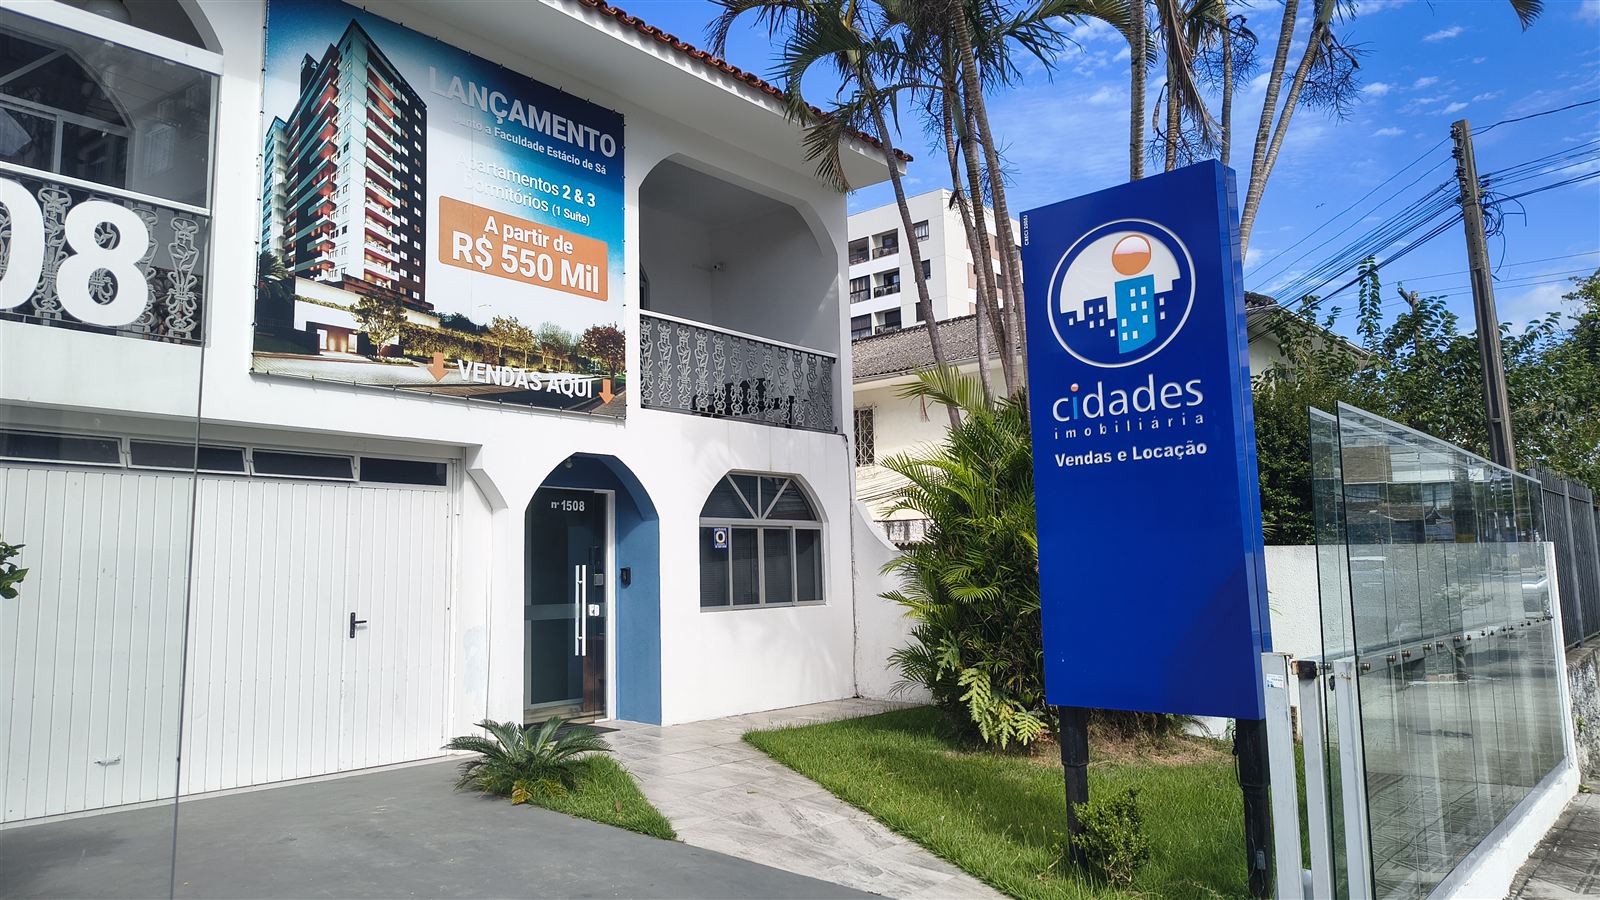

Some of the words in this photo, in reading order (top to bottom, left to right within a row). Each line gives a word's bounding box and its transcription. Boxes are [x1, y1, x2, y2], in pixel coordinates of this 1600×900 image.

[429, 65, 616, 158] LANÇAMENTO
[485, 126, 492, 135] a
[494, 127, 545, 153] Faculdade
[547, 146, 580, 166] Estácio
[582, 158, 593, 171] de
[595, 163, 607, 176] Sá
[456, 151, 559, 196] Apartamentos
[562, 185, 571, 200] 2
[574, 189, 584, 204] &
[587, 193, 596, 208] 3
[463, 170, 549, 213] Dormitórios
[552, 204, 560, 216] (1
[484, 215, 499, 235] A
[503, 223, 550, 248] partir
[553, 234, 574, 255] de
[452, 231, 493, 270] R$
[501, 244, 554, 282] 550
[561, 259, 599, 294] Mil
[457, 359, 543, 391] VENDAS
[547, 375, 592, 399] AQUI
[1052, 374, 1204, 422] cidades
[1054, 414, 1204, 439] imobiliária
[1055, 448, 1112, 467] Vendas
[1117, 449, 1127, 462] e
[1132, 440, 1208, 460] Locação
[561, 500, 585, 511] 1508
